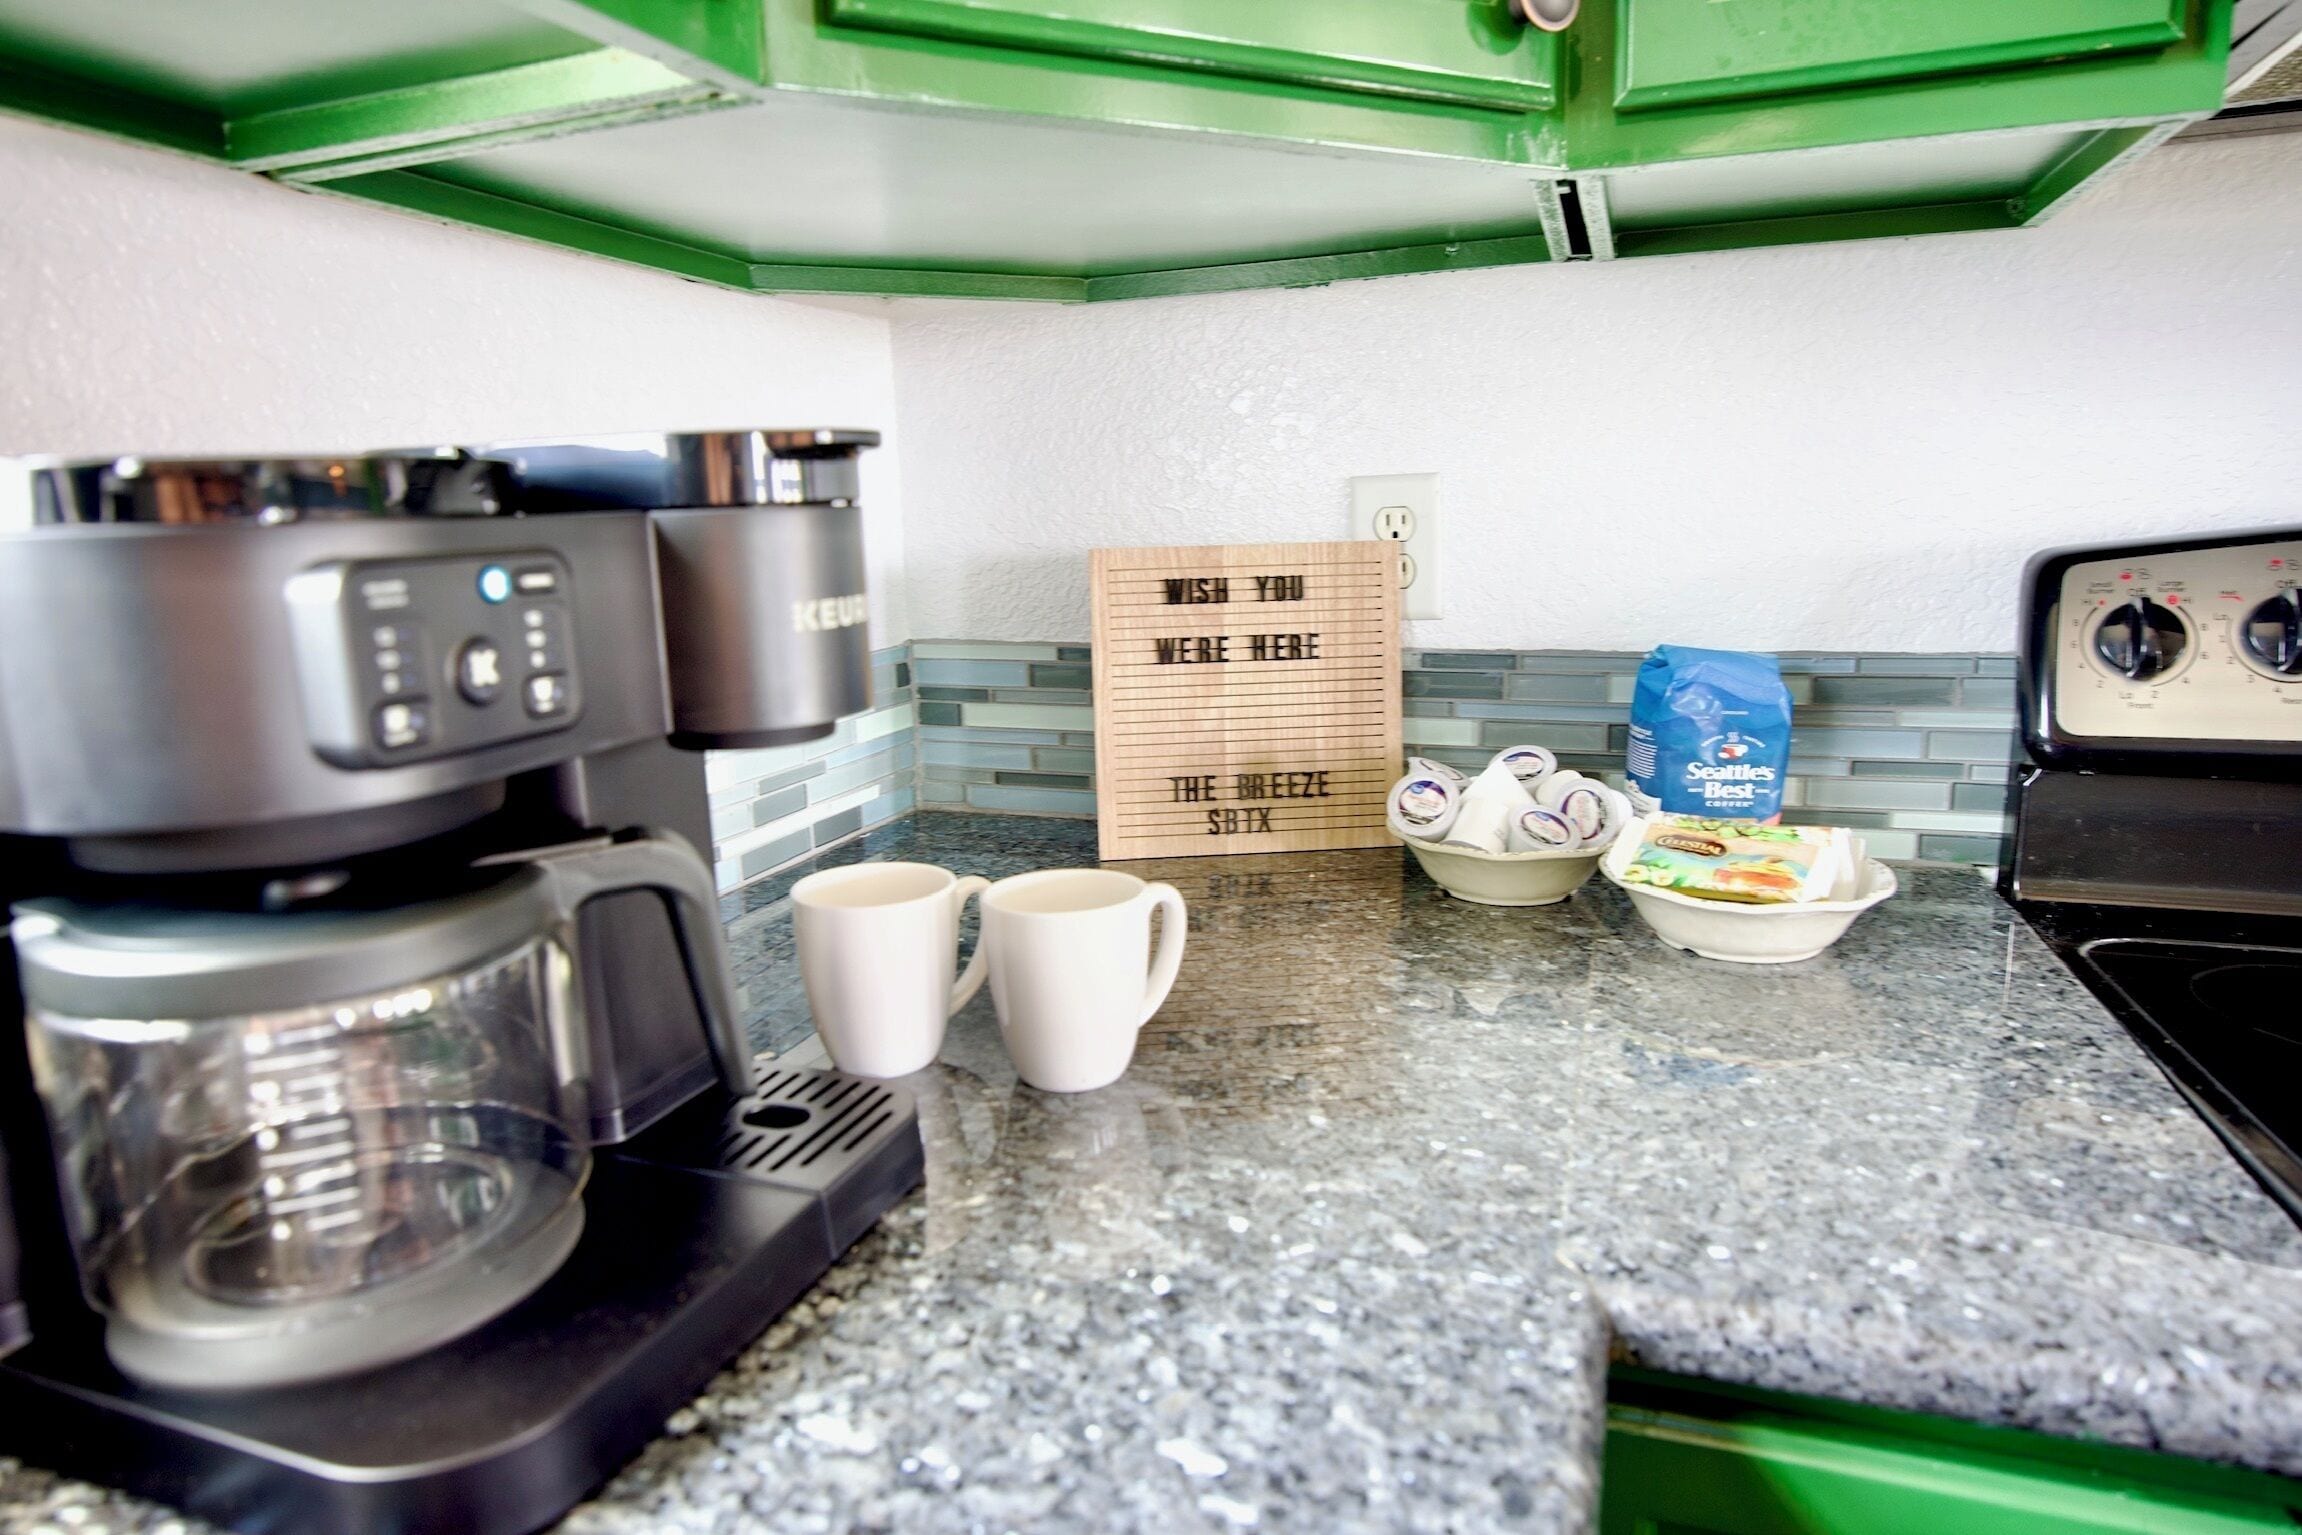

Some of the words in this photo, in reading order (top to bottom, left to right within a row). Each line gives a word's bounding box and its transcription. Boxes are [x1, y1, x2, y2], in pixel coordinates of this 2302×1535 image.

[1163, 578, 1229, 604] WISH
[1256, 575, 1303, 602] YOU
[1155, 637, 1229, 664] WERE
[1249, 633, 1320, 661] HERE
[1686, 762, 1776, 781] Seattle's
[1170, 775, 1216, 802] THE
[1237, 771, 1329, 800] BREEZE
[1704, 782, 1756, 799] Best
[1208, 807, 1272, 835] SBTX
